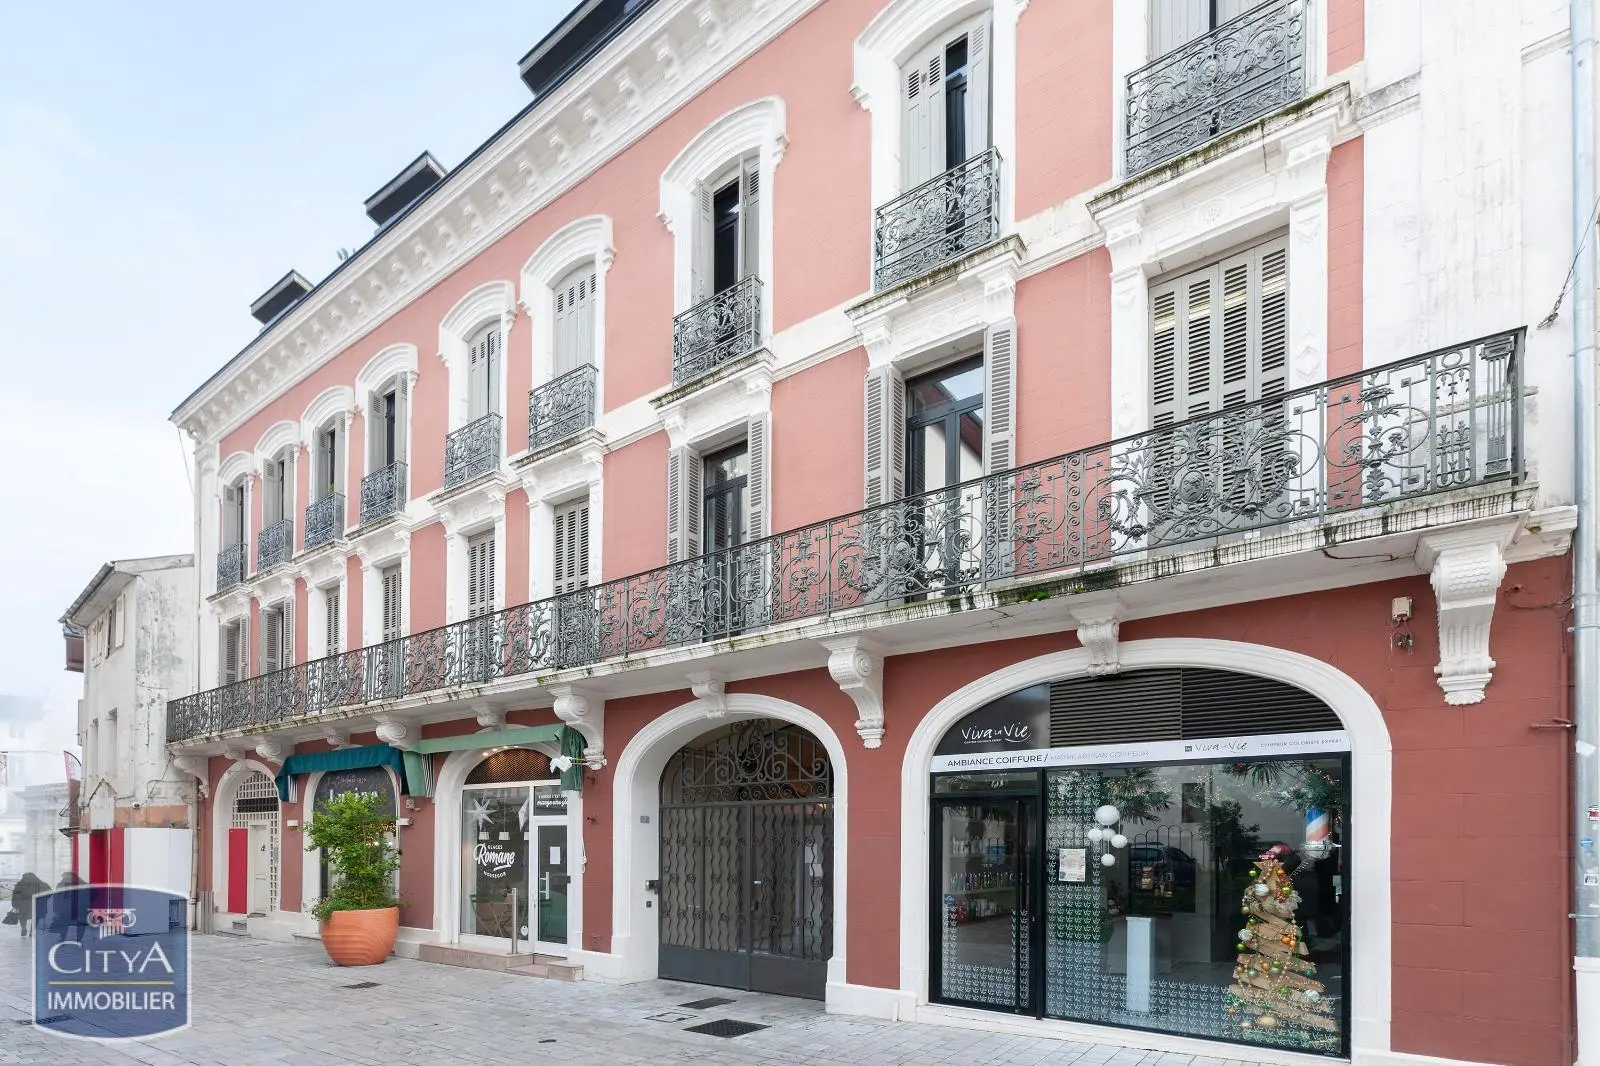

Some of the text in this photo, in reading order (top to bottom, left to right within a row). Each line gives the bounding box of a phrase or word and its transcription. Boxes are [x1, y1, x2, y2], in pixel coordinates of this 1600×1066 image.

[947, 757, 994, 767] AMBIANCE
[995, 754, 1042, 764] COIFFURE
[1077, 750, 1108, 760] ARTISAN
[1109, 748, 1150, 758] COIFFEUR
[473, 843, 515, 870] Romane
